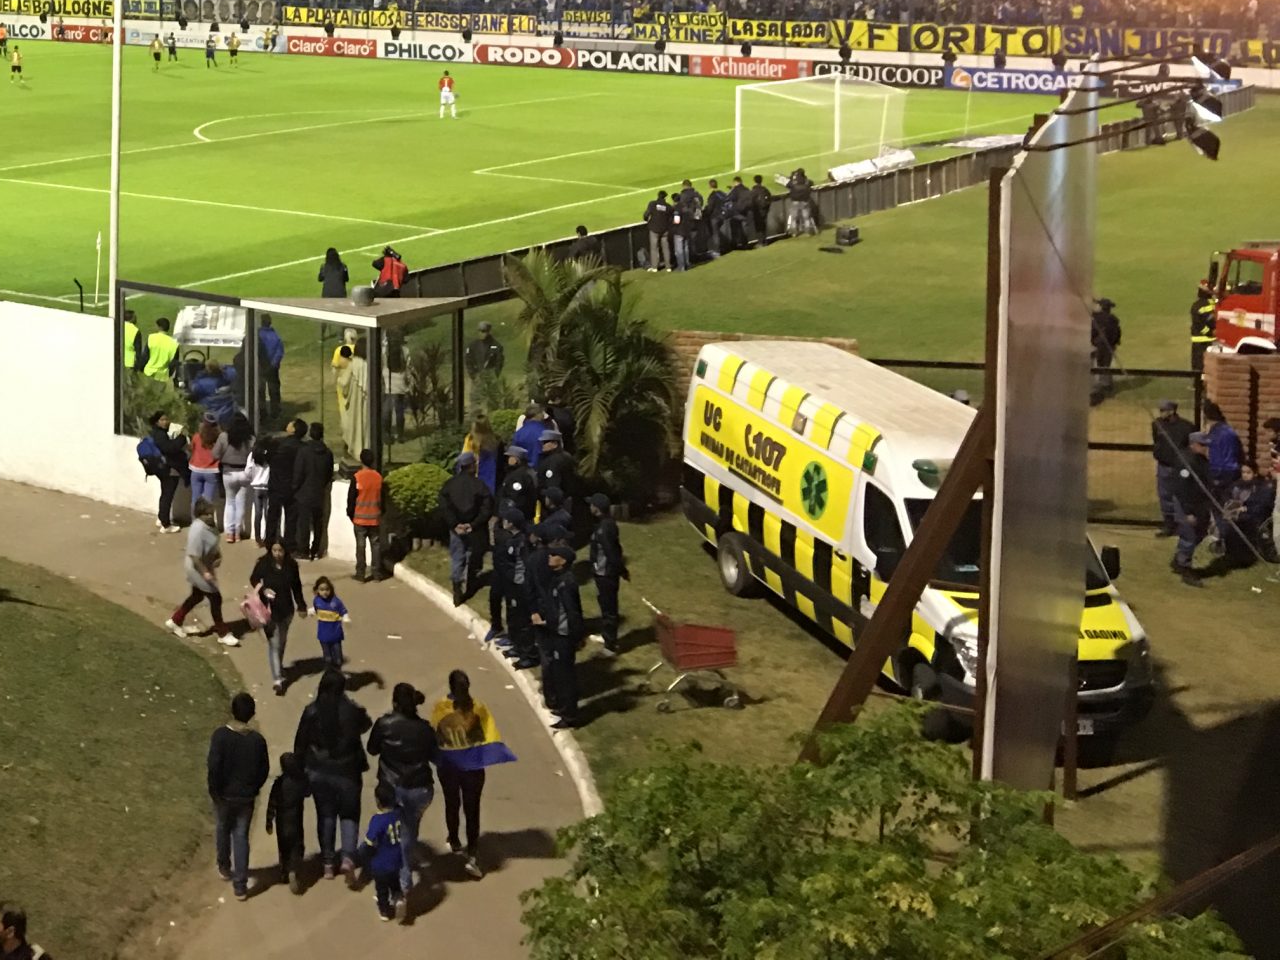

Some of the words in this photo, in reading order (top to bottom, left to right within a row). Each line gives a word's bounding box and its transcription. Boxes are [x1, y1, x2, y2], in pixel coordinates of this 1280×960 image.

[33, 0, 114, 16] BOULOGNE
[284, 6, 302, 22] LA
[306, 7, 350, 24] PLATA
[473, 15, 536, 33] BANFELD
[635, 25, 724, 42] MARTINEZ
[53, 27, 85, 41] Caro
[289, 39, 325, 53] Claro
[333, 41, 370, 56] Claro
[384, 42, 458, 60] PHILCO
[487, 46, 562, 66] RODO
[577, 51, 681, 73] POLACRIN
[711, 56, 787, 78] Schneider
[814, 63, 943, 85] CREDICOOP
[973, 71, 1082, 92] CETROGAR
[703, 400, 723, 432] UC
[752, 431, 787, 472] 107
